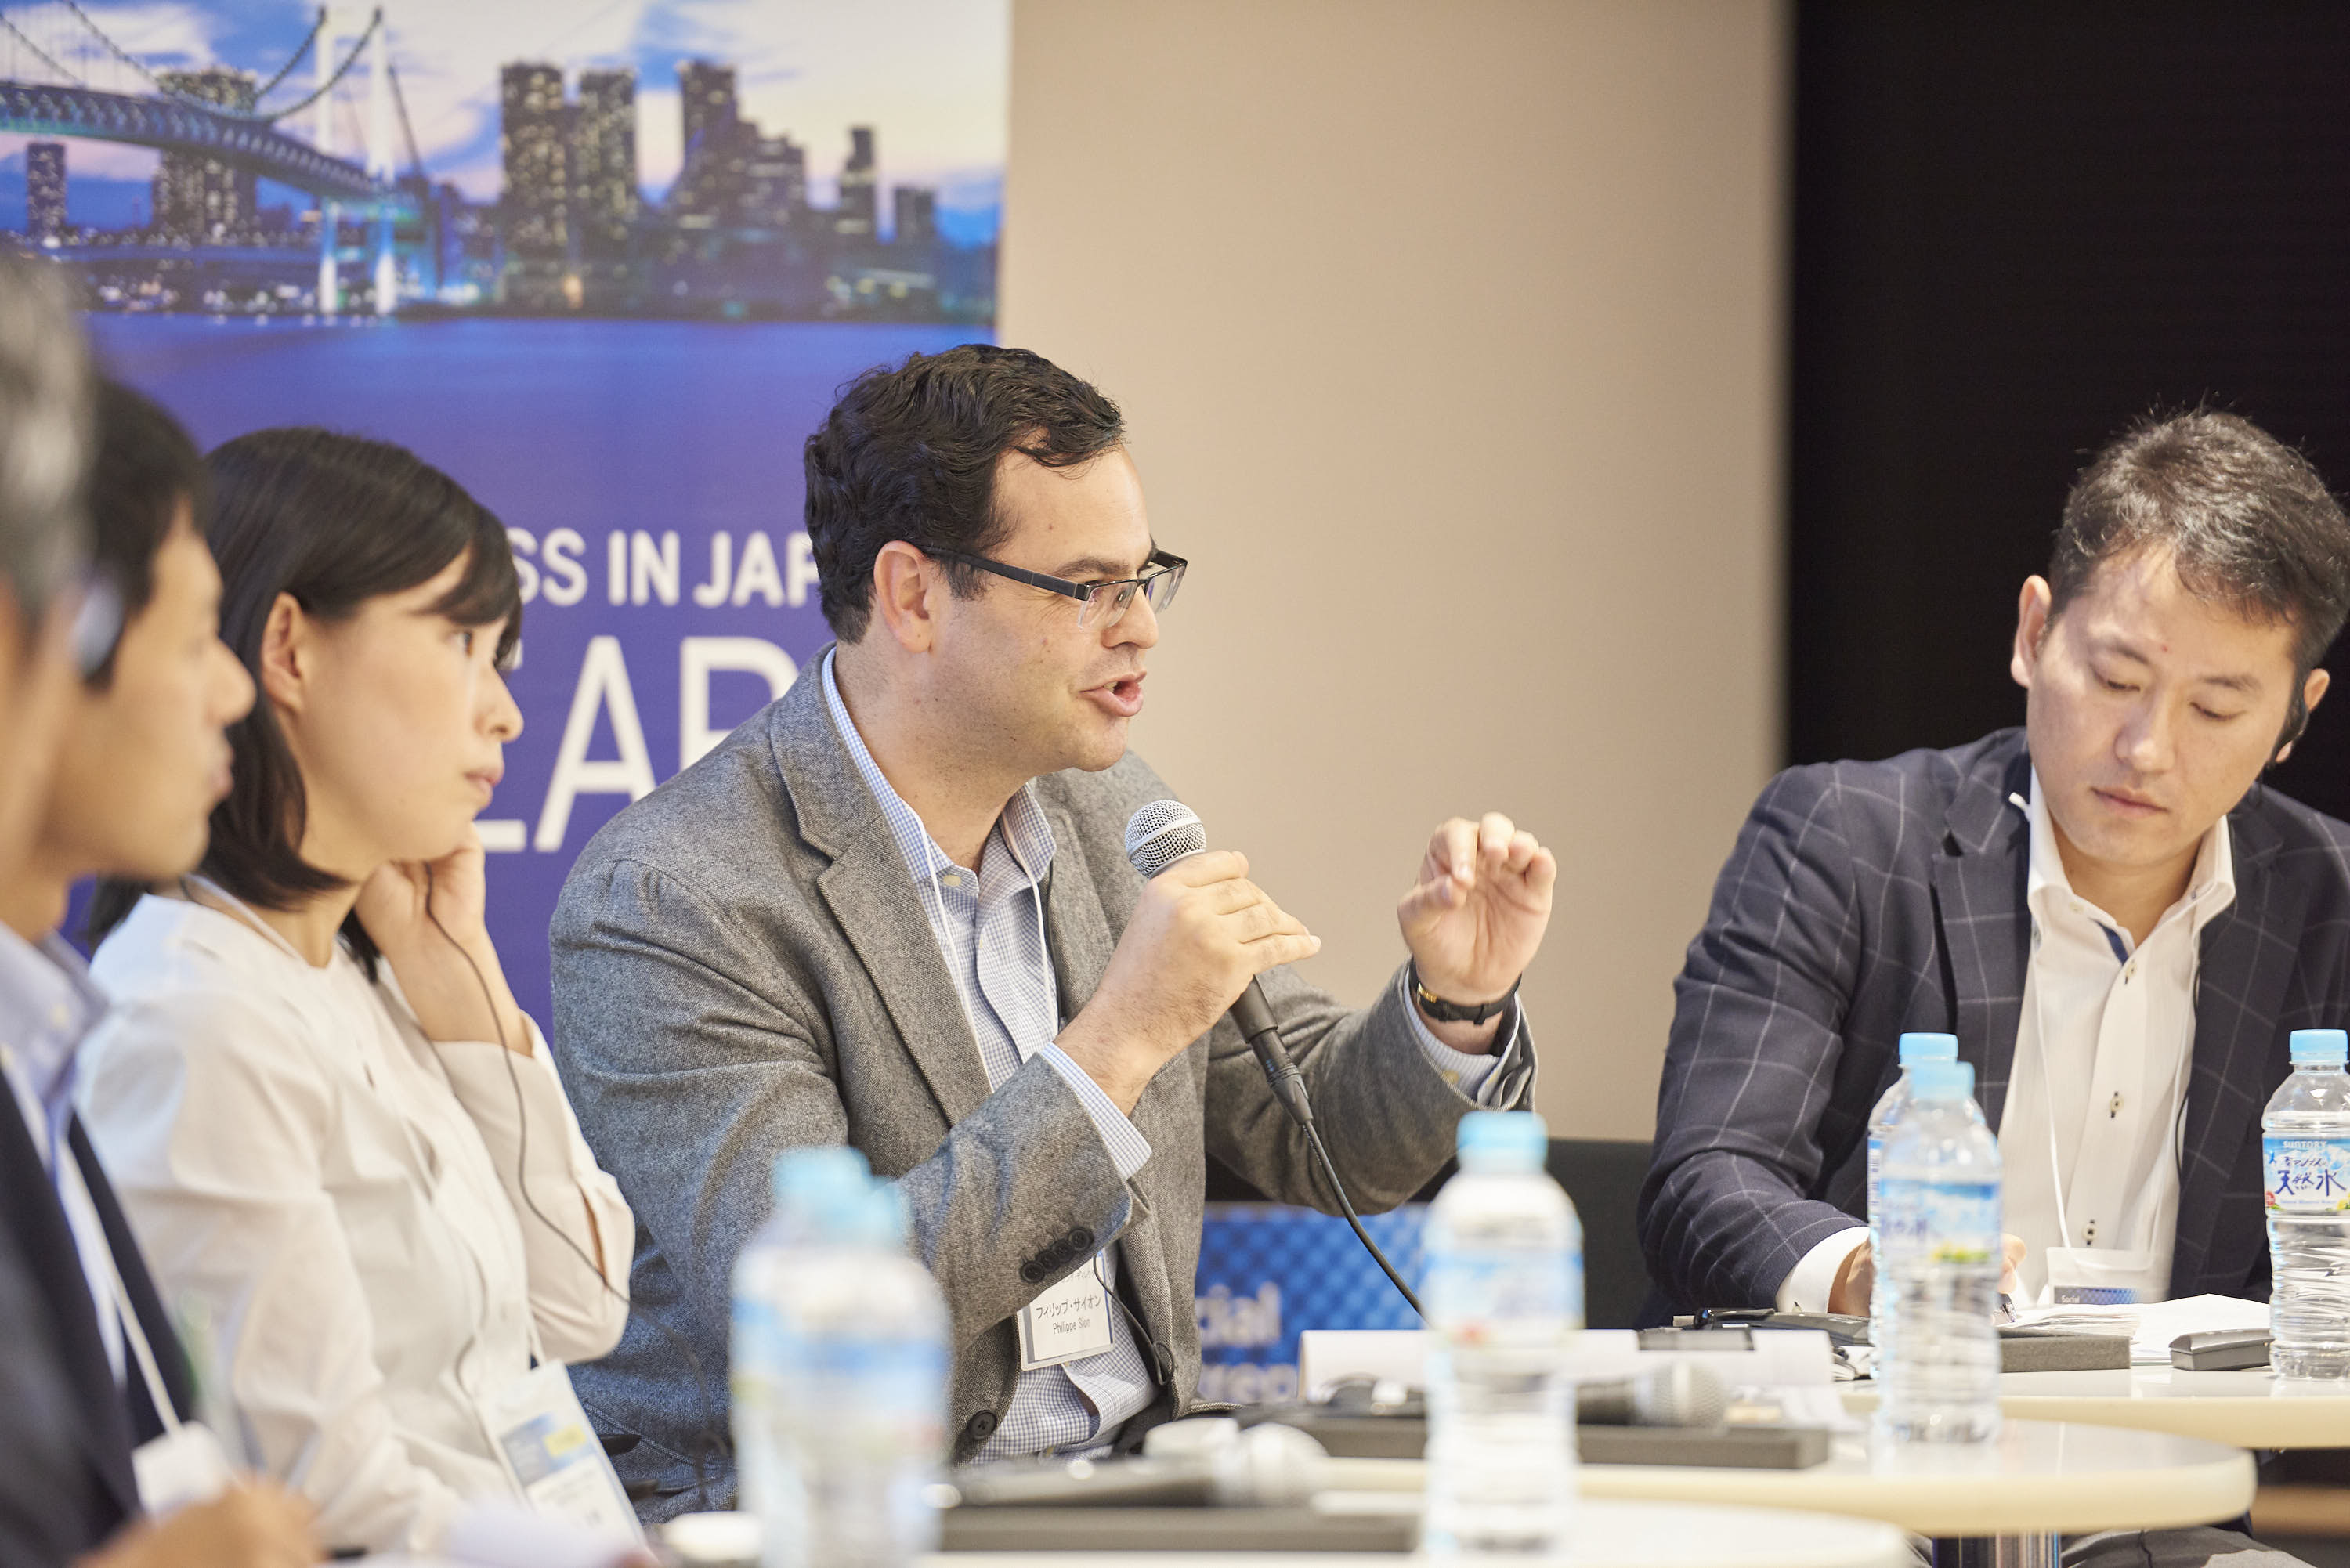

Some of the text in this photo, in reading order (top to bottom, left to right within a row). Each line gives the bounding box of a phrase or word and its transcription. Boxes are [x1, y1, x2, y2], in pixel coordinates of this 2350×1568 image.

[607, 529, 681, 607] IN
[2274, 1169, 2347, 1197] 天然水
[1036, 1294, 1101, 1319] フィリップ・サイオン
[2061, 1295, 2081, 1304] Social
[1053, 1320, 1077, 1335] Philippe
